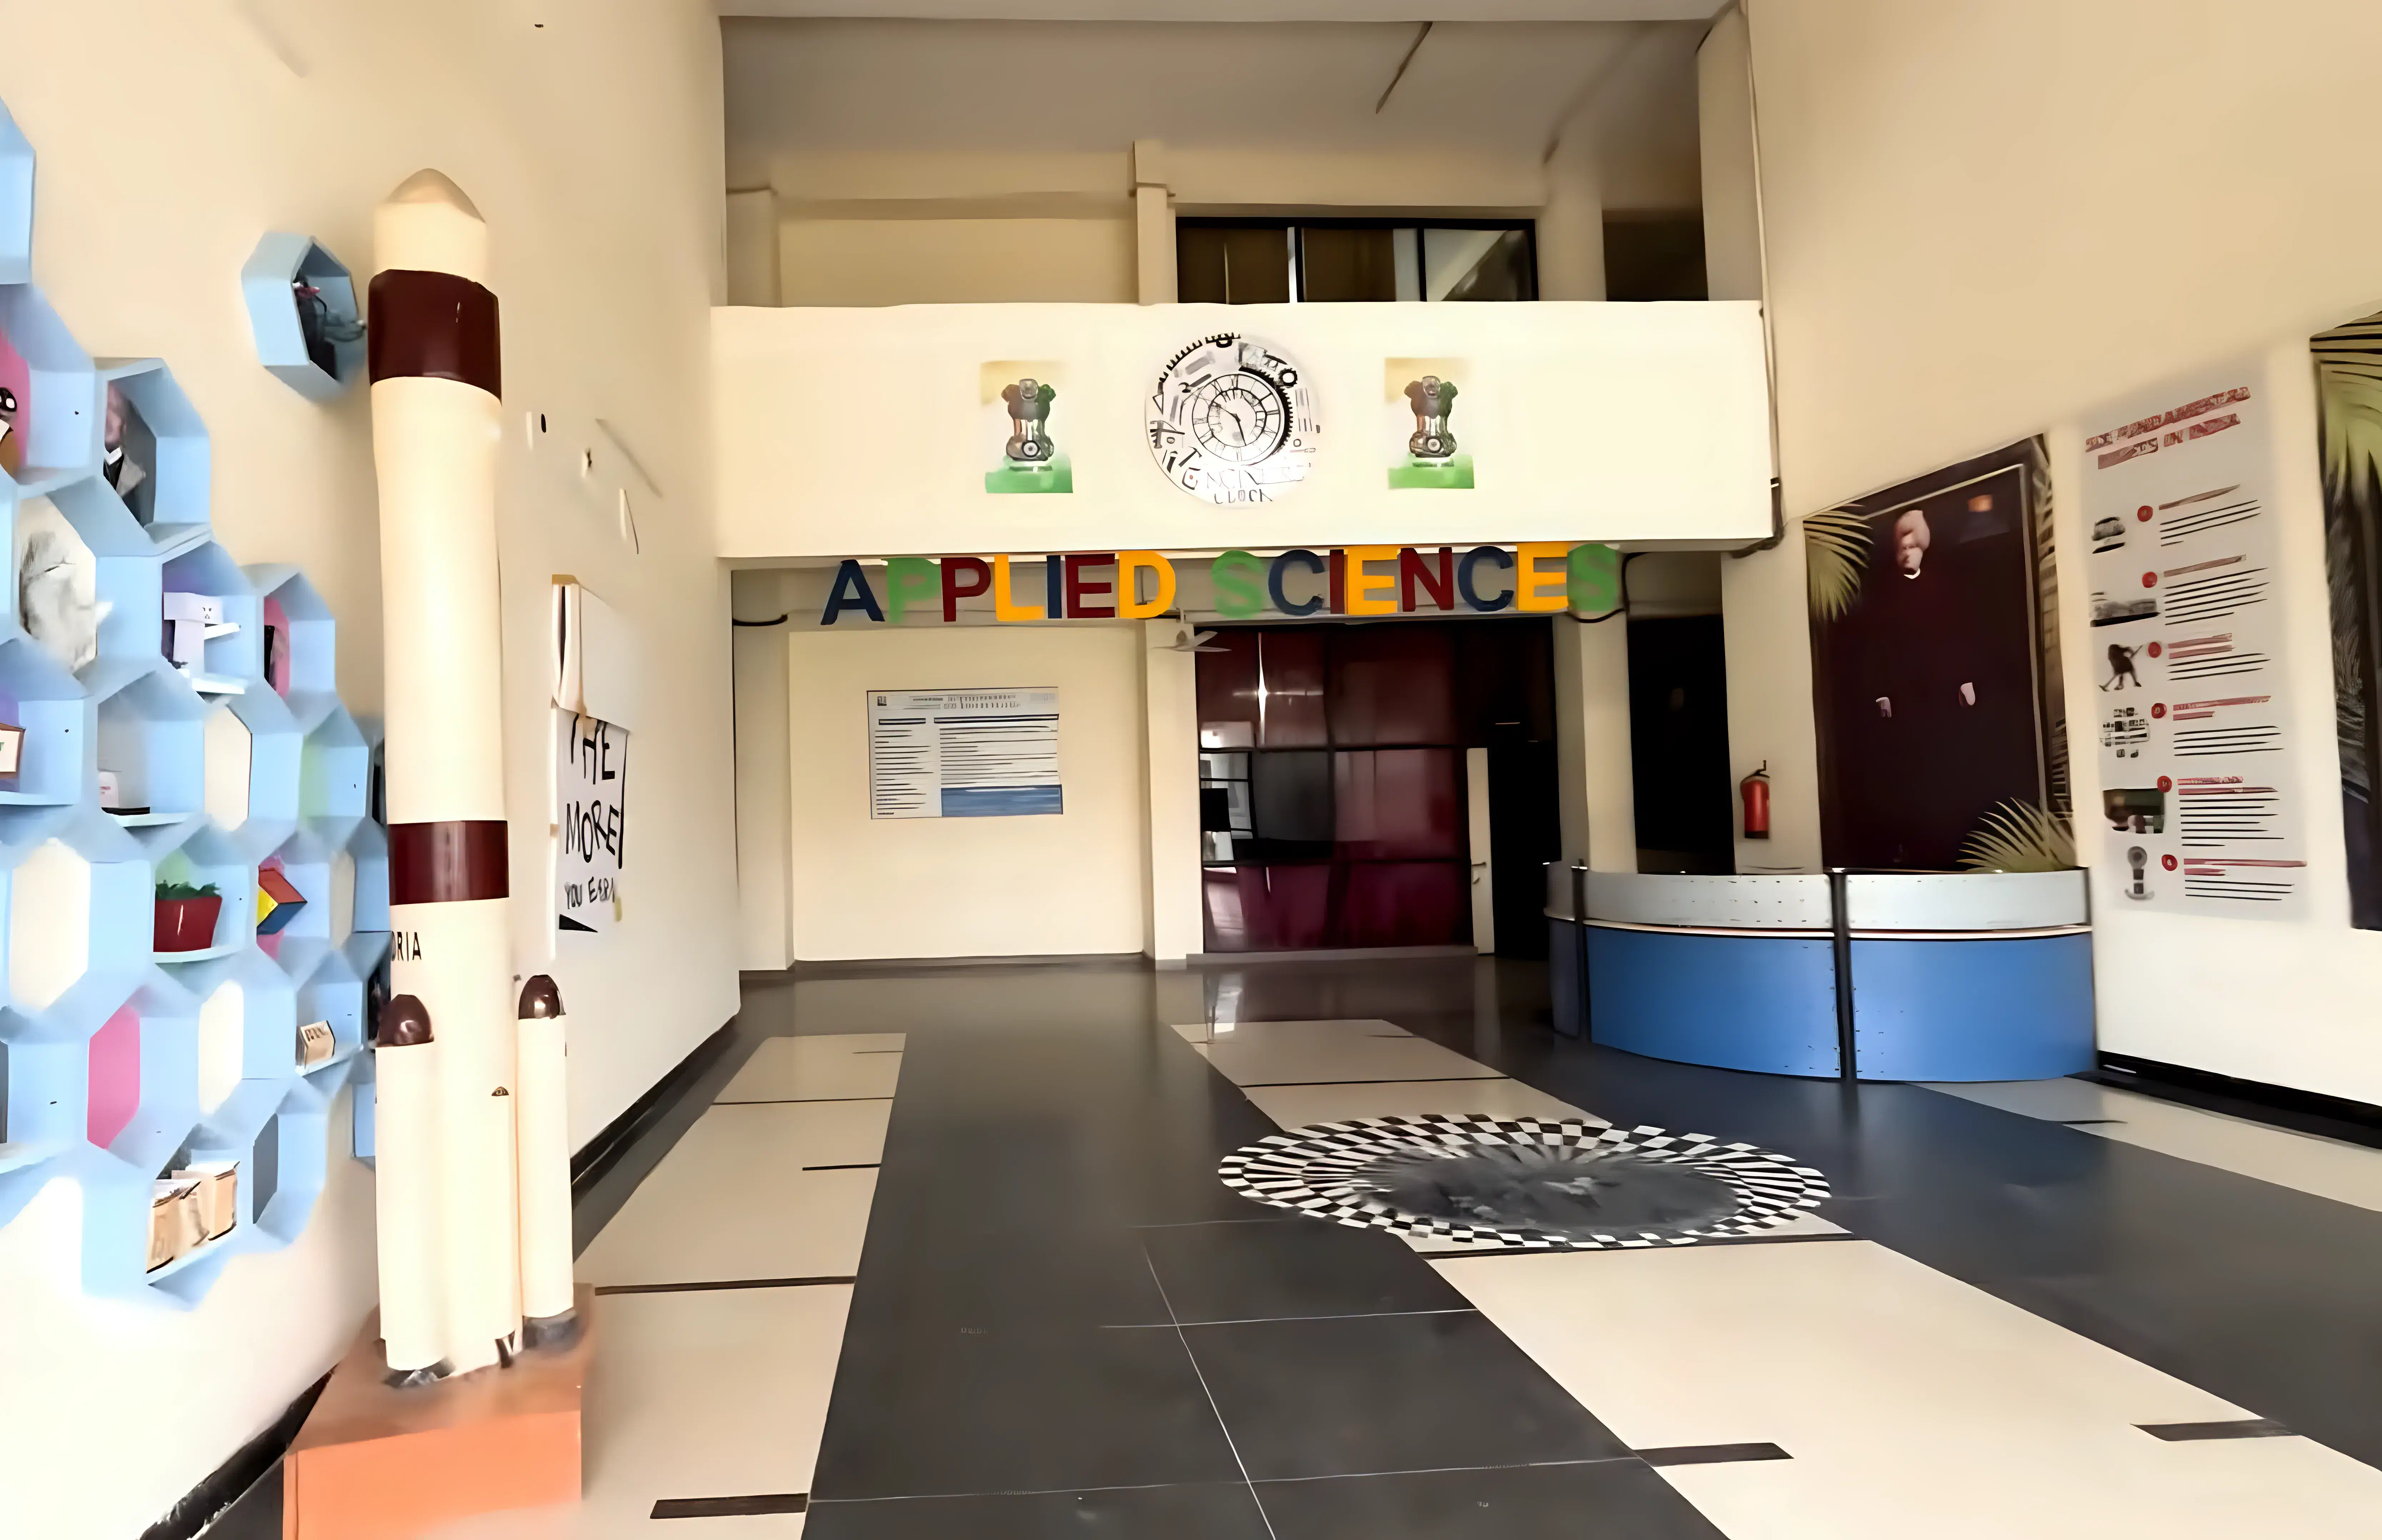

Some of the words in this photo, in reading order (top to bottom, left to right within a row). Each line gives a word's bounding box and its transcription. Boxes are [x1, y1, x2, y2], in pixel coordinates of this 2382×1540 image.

[821, 550, 1177, 624] APPLIED
[1210, 541, 1618, 620] SCIENCES
[565, 800, 620, 864] MORE
